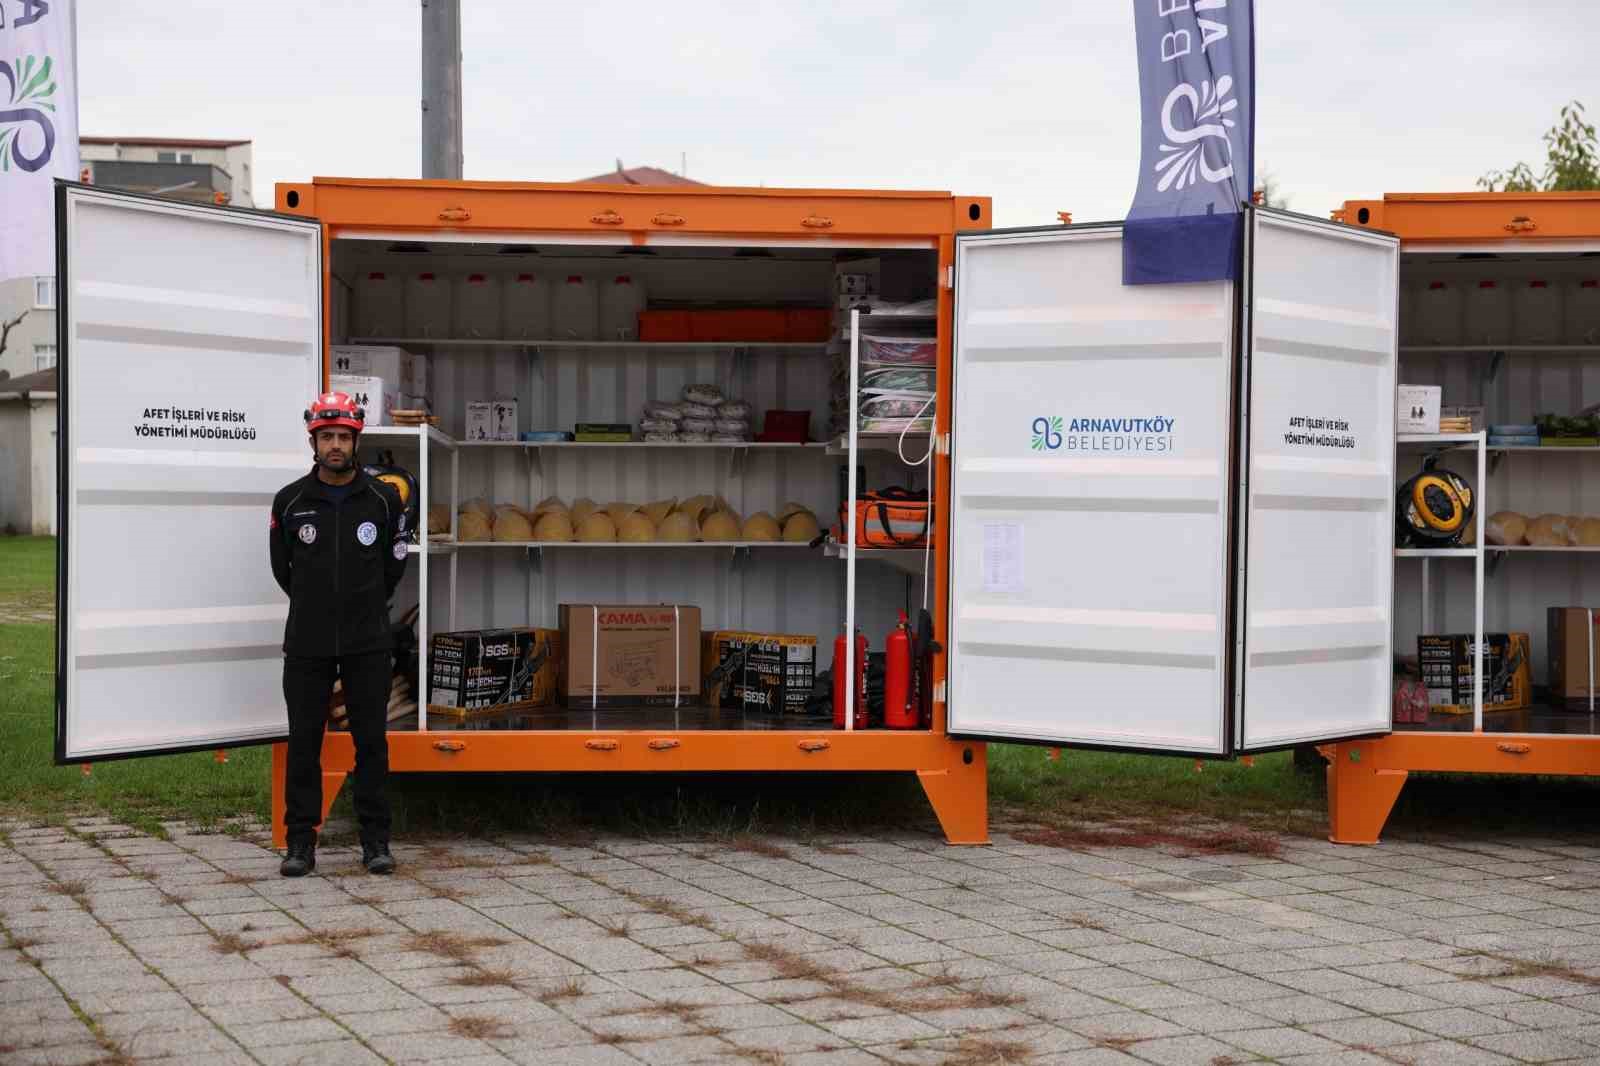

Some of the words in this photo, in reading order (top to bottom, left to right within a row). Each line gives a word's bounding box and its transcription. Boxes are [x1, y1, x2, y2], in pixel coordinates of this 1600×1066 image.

[143, 407, 170, 420] AFET
[172, 406, 205, 423] İŞLERİ
[207, 411, 220, 421] VE
[222, 408, 246, 422] RİSK
[134, 424, 188, 438] YÖNETİMİ
[191, 425, 256, 440] MÜDÜRLÜĞÜ
[1069, 416, 1175, 433] ARNAVUTKÖY
[1067, 435, 1173, 451] BELEDİYESİ
[485, 644, 508, 657] SGS
[744, 690, 766, 705] SGS
